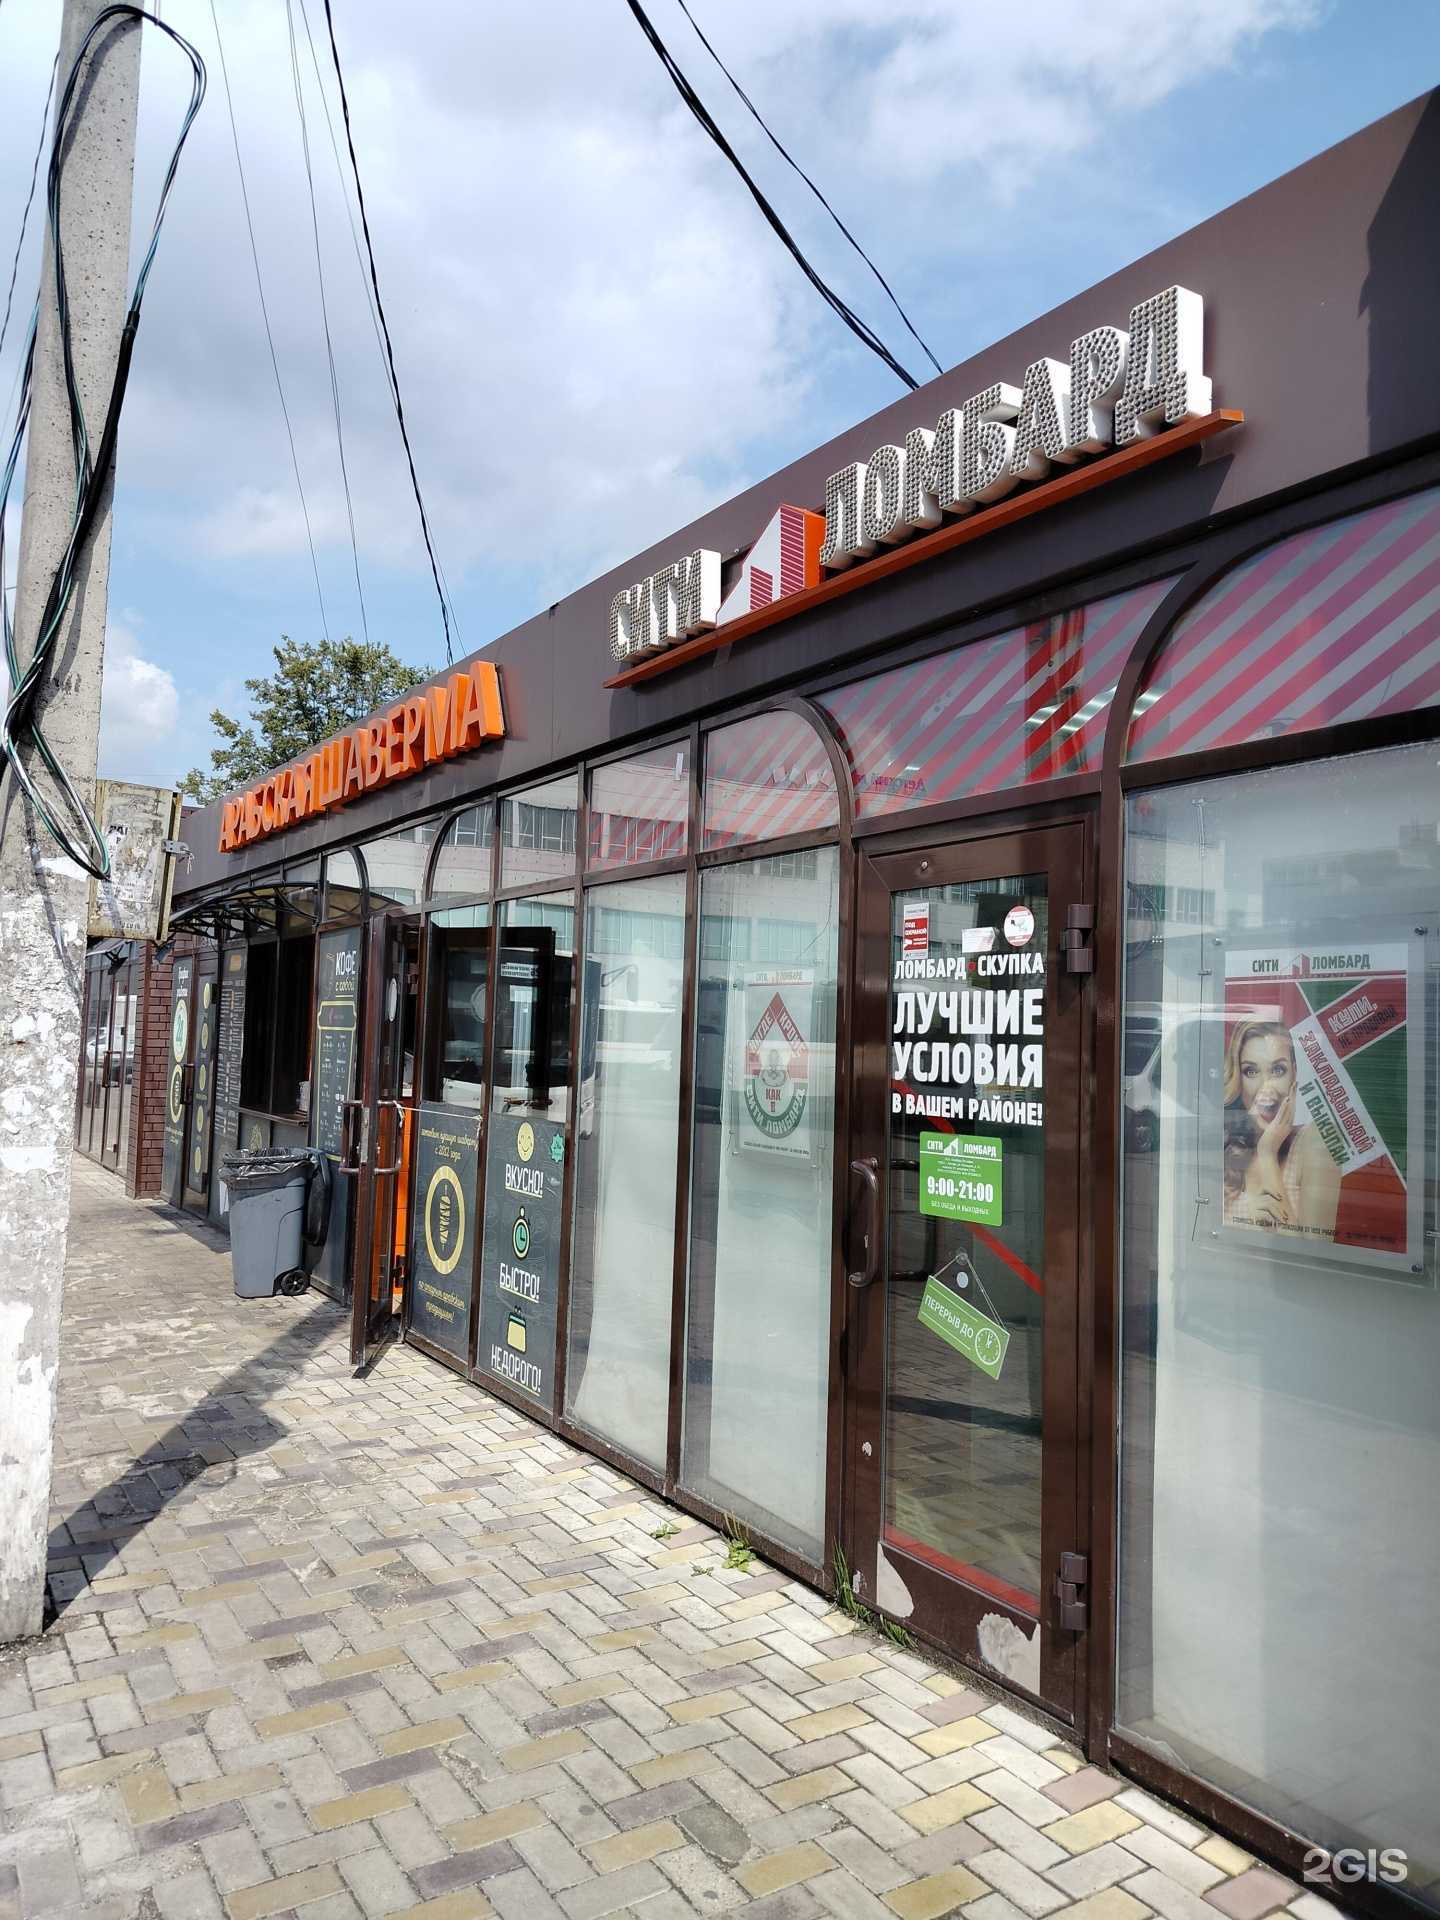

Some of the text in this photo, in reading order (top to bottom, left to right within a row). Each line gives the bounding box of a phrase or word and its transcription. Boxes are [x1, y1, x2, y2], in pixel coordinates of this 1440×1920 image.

[609, 285, 1213, 663] СИТИ ЛОМБАРД
[219, 660, 505, 853] АРАБСКАЯ ШАВЕРМА
[335, 950, 356, 976] КОФЕ
[894, 952, 1045, 980] ЛОМБАРД СКУПКА
[1251, 953, 1371, 972] СИТИ ЛОМБАРД
[893, 988, 1045, 1037] ЛУЧШИЕ
[1328, 995, 1378, 1033] КУПИ,
[893, 1042, 1045, 1088] УСЛОВИЯ
[766, 1088, 781, 1101] КАК
[892, 1094, 1044, 1127] В ВАШЕМ РАЙОНЕ!
[1298, 1031, 1377, 1154] ЗАКЛАДЫВАЙ
[1299, 1081, 1355, 1166] И ВЫКУПАЙ
[927, 1140, 997, 1158] СИТИ ЛОМБАРД
[504, 1163, 544, 1195] ВКУСНО!
[927, 1176, 994, 1203] 9:00-21:00
[499, 1263, 541, 1300] БЫСТРО!
[924, 1294, 974, 1339] ПЕРЕРЫВ ДО
[491, 1344, 542, 1394] НЕДОРОГО!
